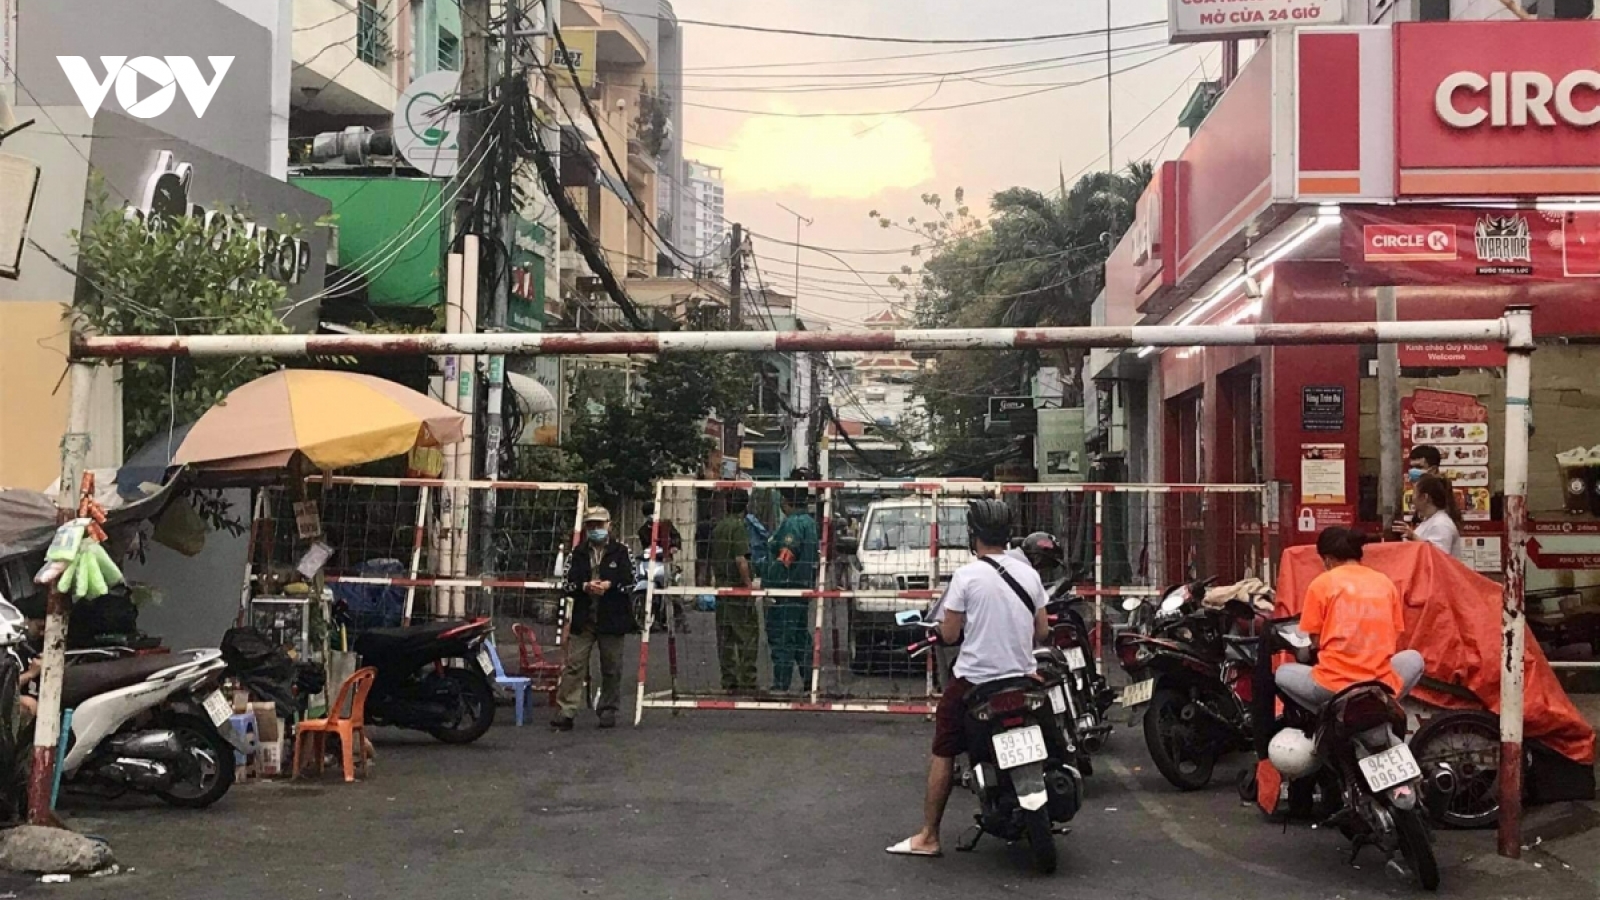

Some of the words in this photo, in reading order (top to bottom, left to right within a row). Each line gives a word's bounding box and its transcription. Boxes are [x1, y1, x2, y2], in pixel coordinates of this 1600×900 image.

[1230, 6, 1265, 23] CỬA
[1269, 9, 1289, 21] 24
[1292, 3, 1321, 19] GIỜ
[1435, 69, 1600, 128] CIRC
[1371, 234, 1425, 247] CIRCLE
[1431, 232, 1448, 249] K
[1476, 236, 1530, 261] WARRIOR
[1427, 353, 1466, 361] Welcome
[1000, 730, 1033, 750] 59-T1
